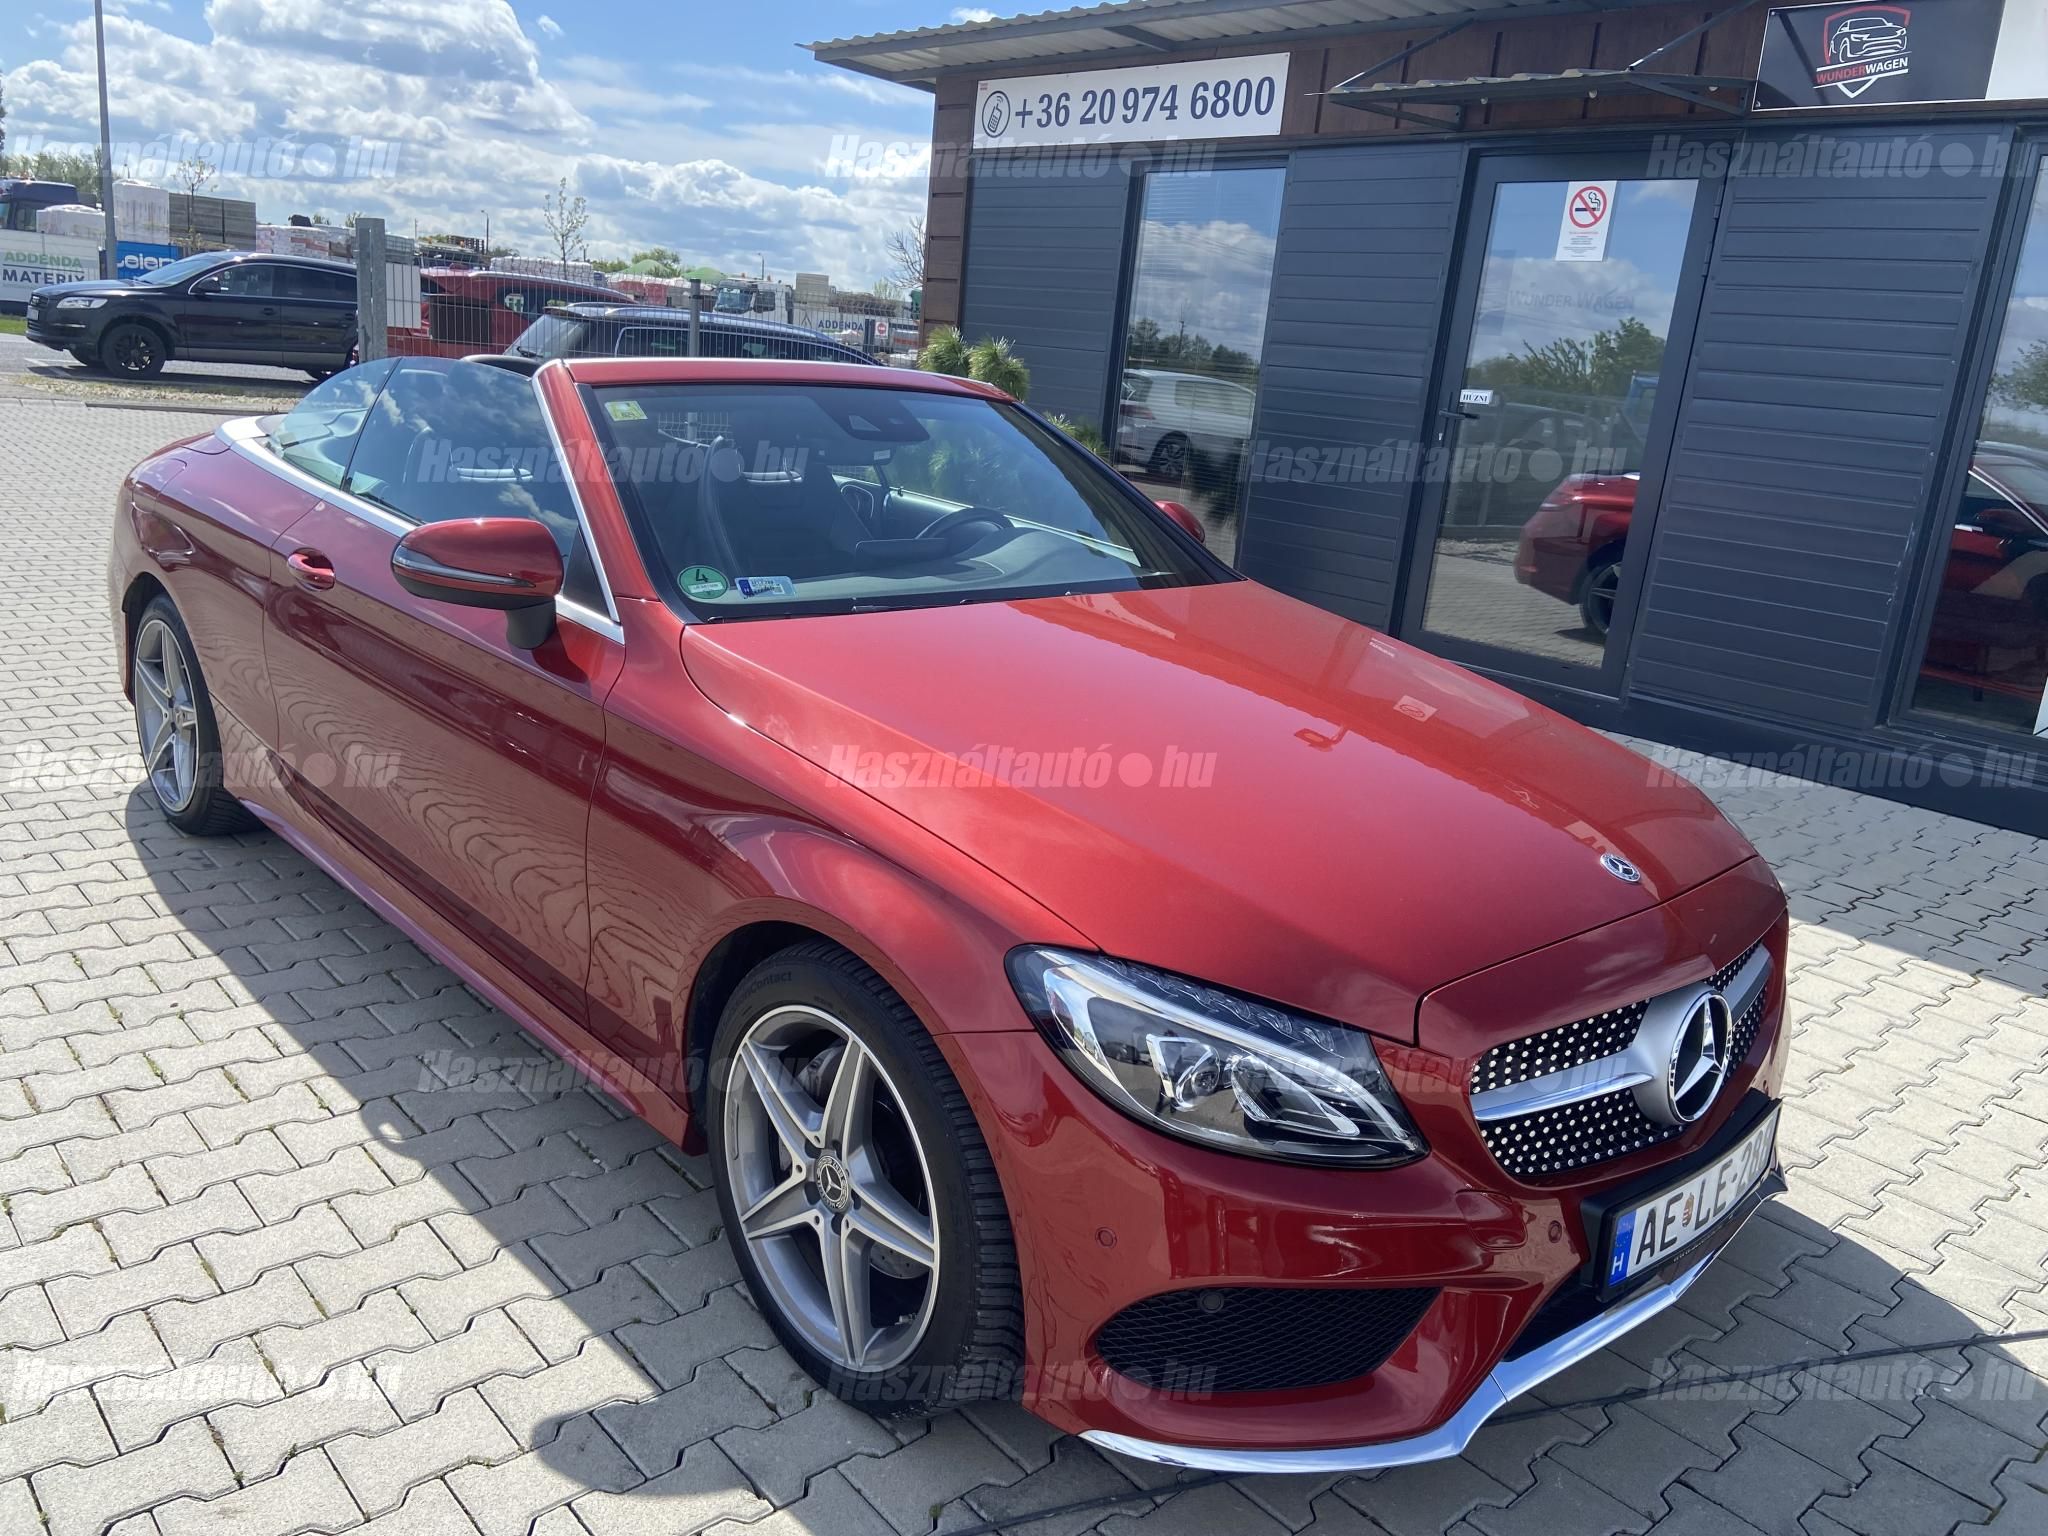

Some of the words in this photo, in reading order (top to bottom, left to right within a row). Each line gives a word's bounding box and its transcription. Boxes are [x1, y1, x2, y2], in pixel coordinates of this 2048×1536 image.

[1815, 56, 1908, 84] WUNDERWAGEN
[1015, 92, 1071, 128] +36
[1079, 88, 1116, 125] 20
[1122, 84, 1179, 124] 974
[1190, 76, 1275, 120] 6800
[4, 252, 83, 267] ADDENDA
[818, 320, 864, 331] ADDENDA
[695, 568, 708, 582] 4
[1635, 1192, 1684, 1265] AE
[1610, 1255, 1622, 1275] H
